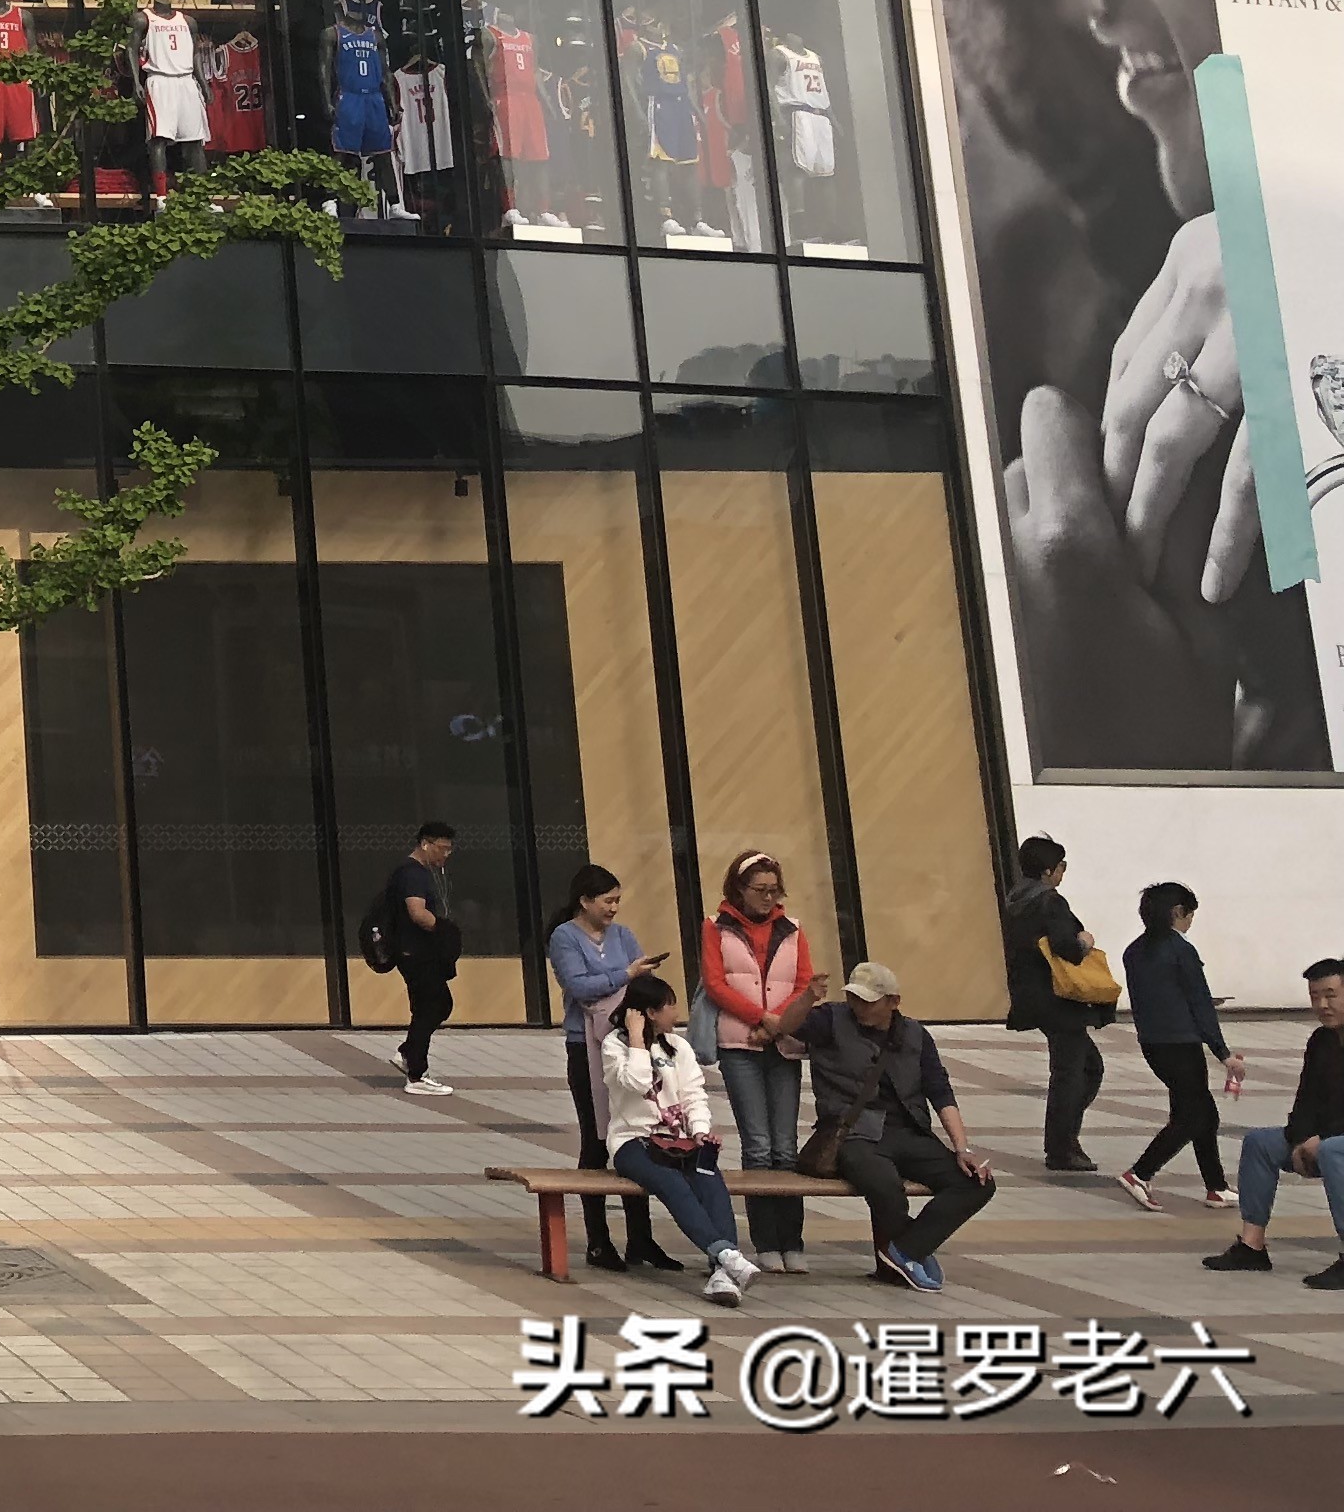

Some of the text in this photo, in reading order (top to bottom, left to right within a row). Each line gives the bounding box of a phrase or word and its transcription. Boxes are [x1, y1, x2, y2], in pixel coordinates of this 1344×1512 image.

[168, 34, 178, 51] 3
[359, 60, 368, 76] 0
[516, 52, 525, 70] 9
